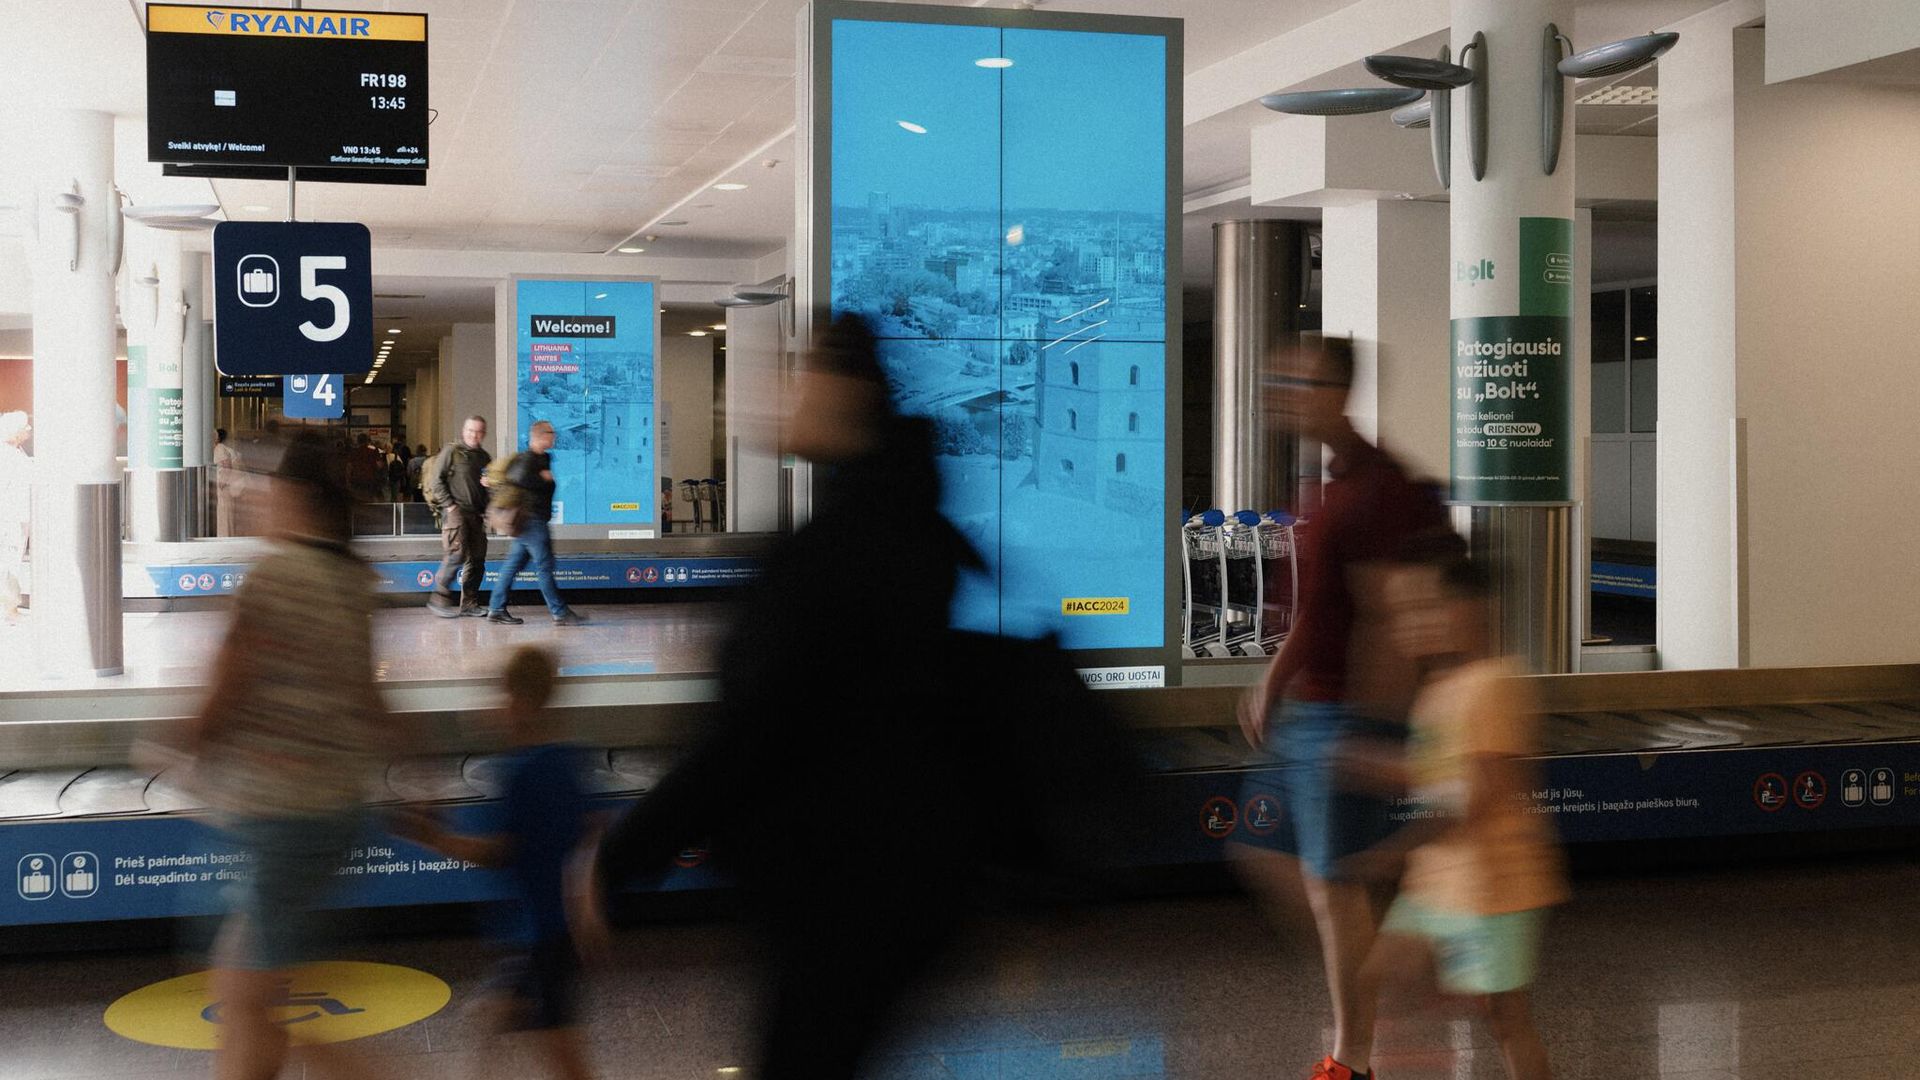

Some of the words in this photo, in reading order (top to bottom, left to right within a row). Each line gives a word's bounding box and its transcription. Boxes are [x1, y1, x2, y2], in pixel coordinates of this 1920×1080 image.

[230, 13, 370, 36] RYANAIR
[360, 73, 407, 88] FR198
[370, 96, 406, 110] 13:45
[228, 143, 265, 152] Welcome!
[342, 146, 358, 154] VNO
[1456, 258, 1494, 281] Bolt
[298, 255, 350, 342] 5
[535, 320, 610, 334] Welcome!
[1457, 337, 1561, 360] Patogiausia
[1456, 359, 1528, 378] važiuoti
[312, 373, 337, 406] 4
[1457, 387, 1472, 399] su
[1478, 411, 1514, 420] kelionei
[1488, 425, 1536, 433] RIDENOW
[1487, 439, 1497, 447] 10
[1499, 439, 1508, 447] €
[1066, 601, 1125, 611] #IACC2024
[1105, 671, 1125, 682] ORO
[1128, 670, 1161, 681] UOSTAI
[1532, 789, 1549, 800] kad
[1550, 789, 1561, 800] jis
[1563, 788, 1585, 800] Jūsų.
[1523, 804, 1560, 816] prašome
[1563, 801, 1596, 813] kreiptis
[1603, 798, 1634, 811] bagažo
[1636, 798, 1674, 809] paieškos
[1675, 797, 1700, 808] biurą.
[115, 856, 145, 869] Prieš
[148, 853, 207, 868] paimdami
[367, 846, 395, 859] Jūsų.
[115, 873, 135, 886] Dėl
[137, 871, 197, 886] sugadinto
[200, 871, 213, 881] ar
[367, 860, 410, 874] kreiptis
[419, 857, 460, 872] bagažo
